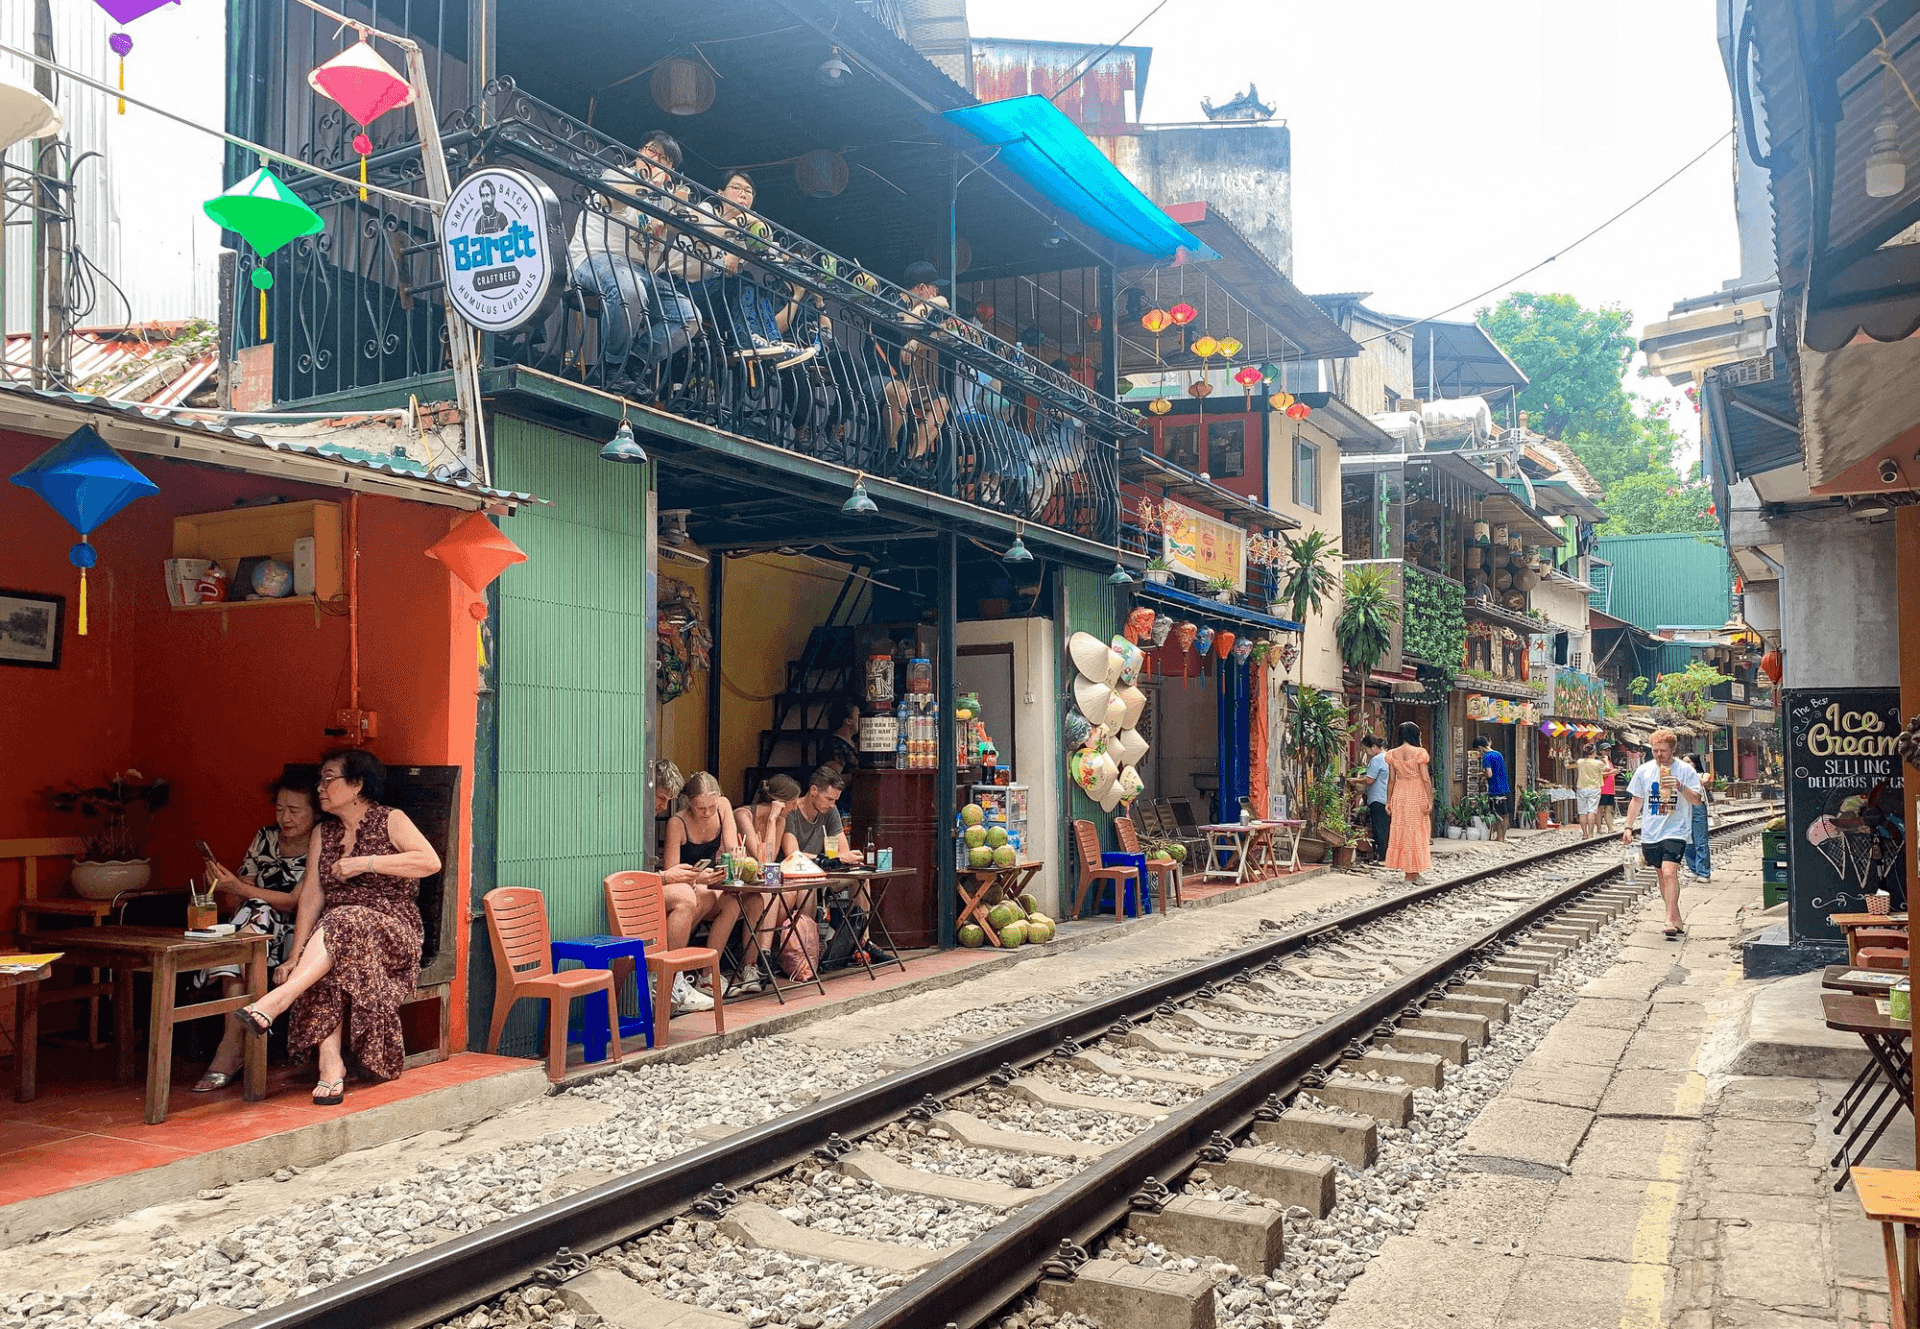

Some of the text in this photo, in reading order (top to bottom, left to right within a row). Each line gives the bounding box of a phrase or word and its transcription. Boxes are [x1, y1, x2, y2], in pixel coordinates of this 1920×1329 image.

[451, 184, 528, 227] SMALL BATCH
[449, 220, 536, 270] Barett
[458, 272, 536, 314] HUMULUS LUPULUS
[476, 270, 516, 286] CRAFT BEER
[1792, 697, 1829, 718] The Best
[1825, 703, 1885, 733] Ice
[1807, 723, 1900, 756] Cream
[1808, 776, 1867, 789] DELICIOUS
[1824, 760, 1890, 775] SELLING
